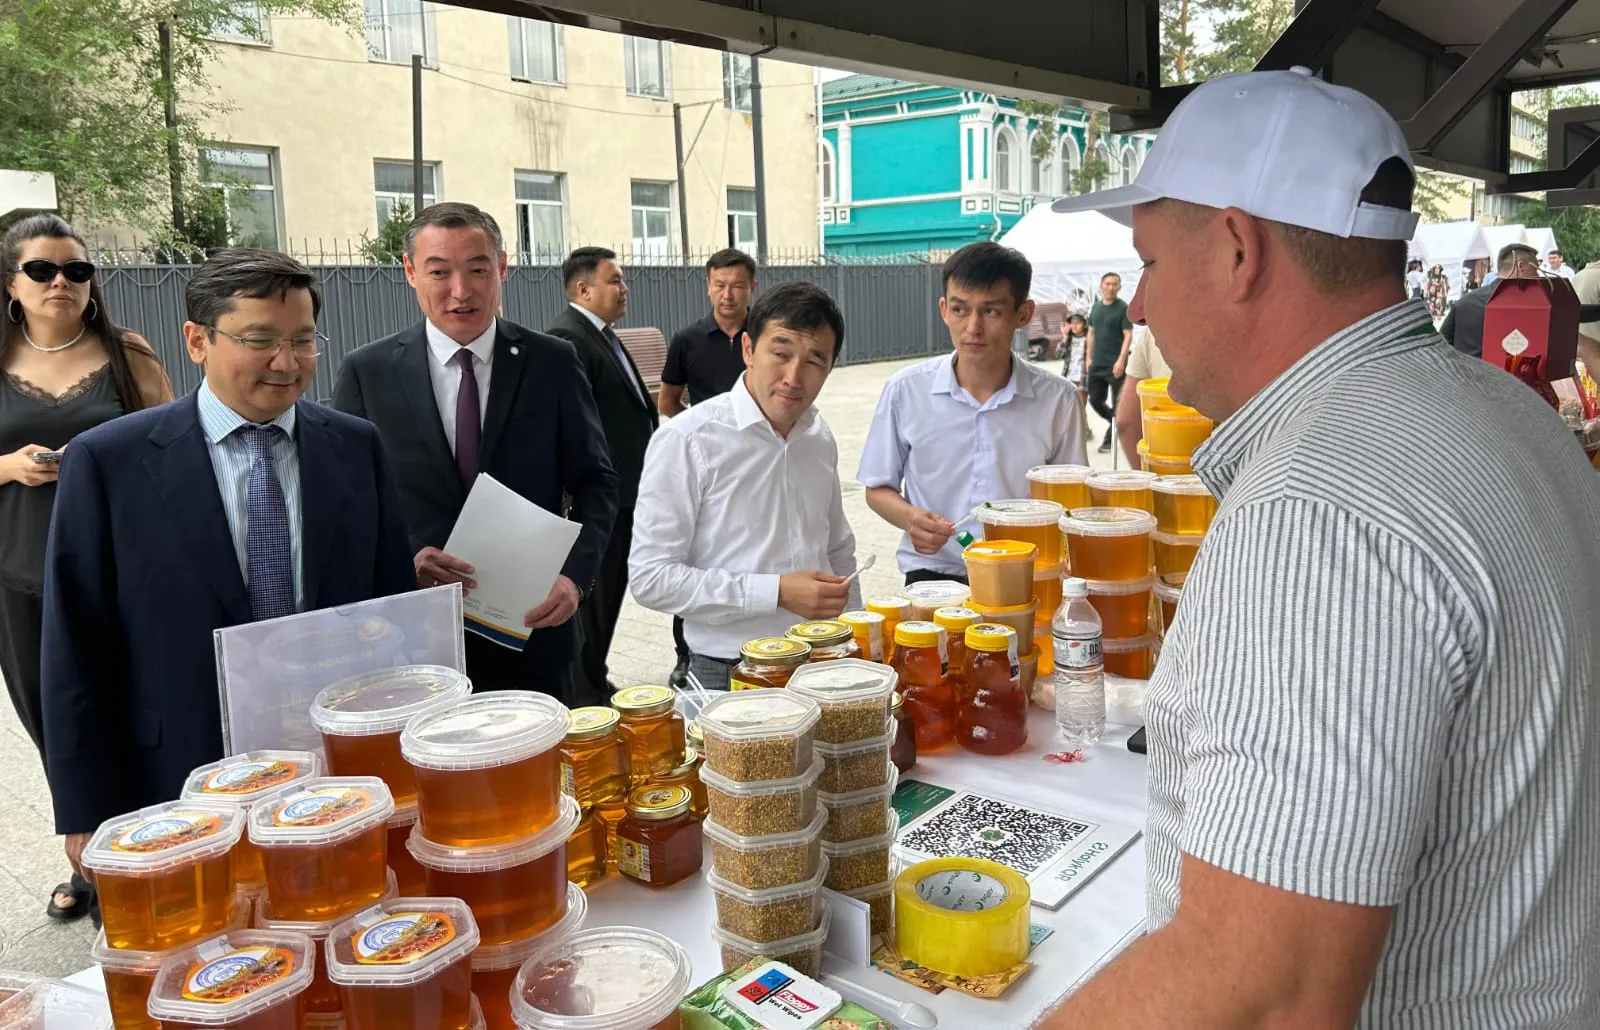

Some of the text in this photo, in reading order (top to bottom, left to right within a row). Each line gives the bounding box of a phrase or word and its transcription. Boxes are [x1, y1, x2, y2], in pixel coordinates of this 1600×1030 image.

[768, 998, 802, 1020] Wet Wipes
[779, 990, 814, 1012] Floppy
